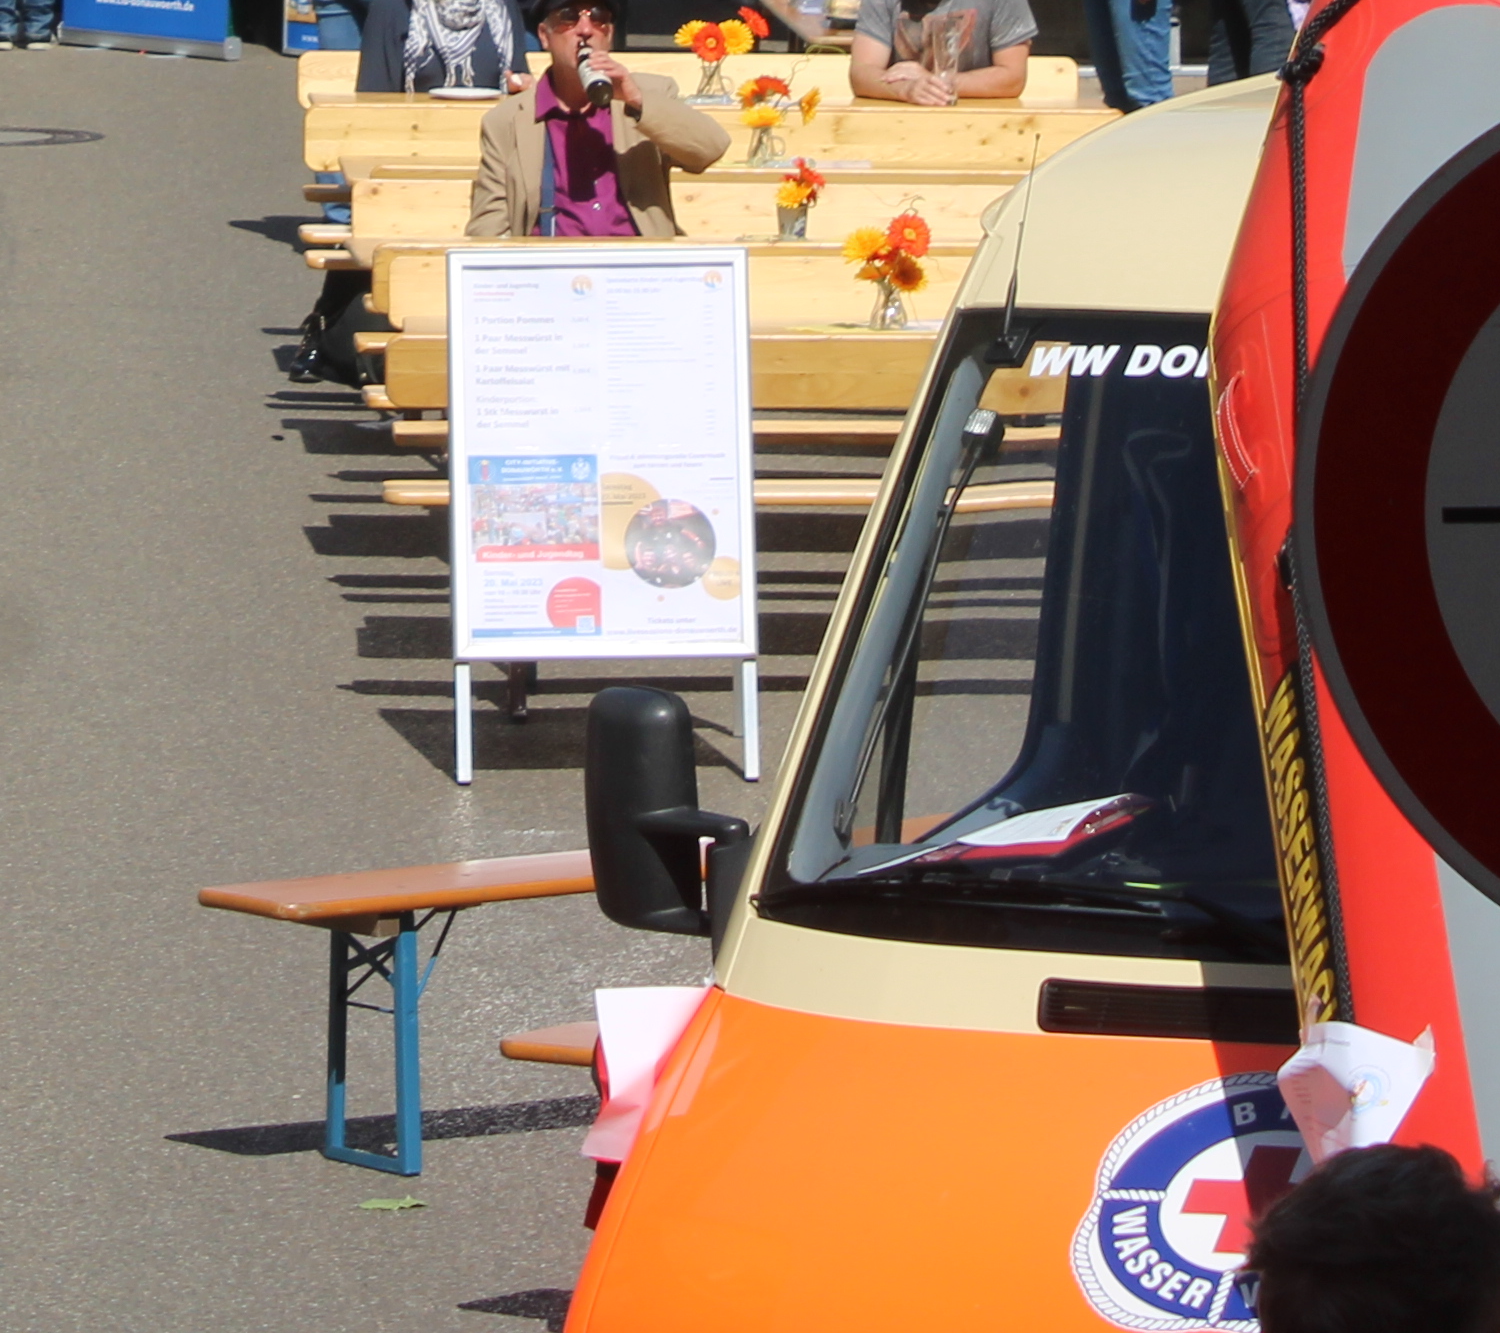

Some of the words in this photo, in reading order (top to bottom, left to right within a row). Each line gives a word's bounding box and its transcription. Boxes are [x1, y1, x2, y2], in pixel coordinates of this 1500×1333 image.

[481, 316, 514, 324] Portion
[516, 316, 555, 324] Pommes
[1029, 345, 1121, 377] WW
[483, 365, 501, 373] Paar
[476, 377, 535, 385] Kartoffelsalat
[476, 420, 490, 428] der
[494, 420, 529, 428] Semmel
[482, 551, 516, 559] Kinder-
[517, 551, 535, 559] und
[537, 550, 584, 560] Jugendtag
[1112, 1205, 1213, 1309] WASSER
